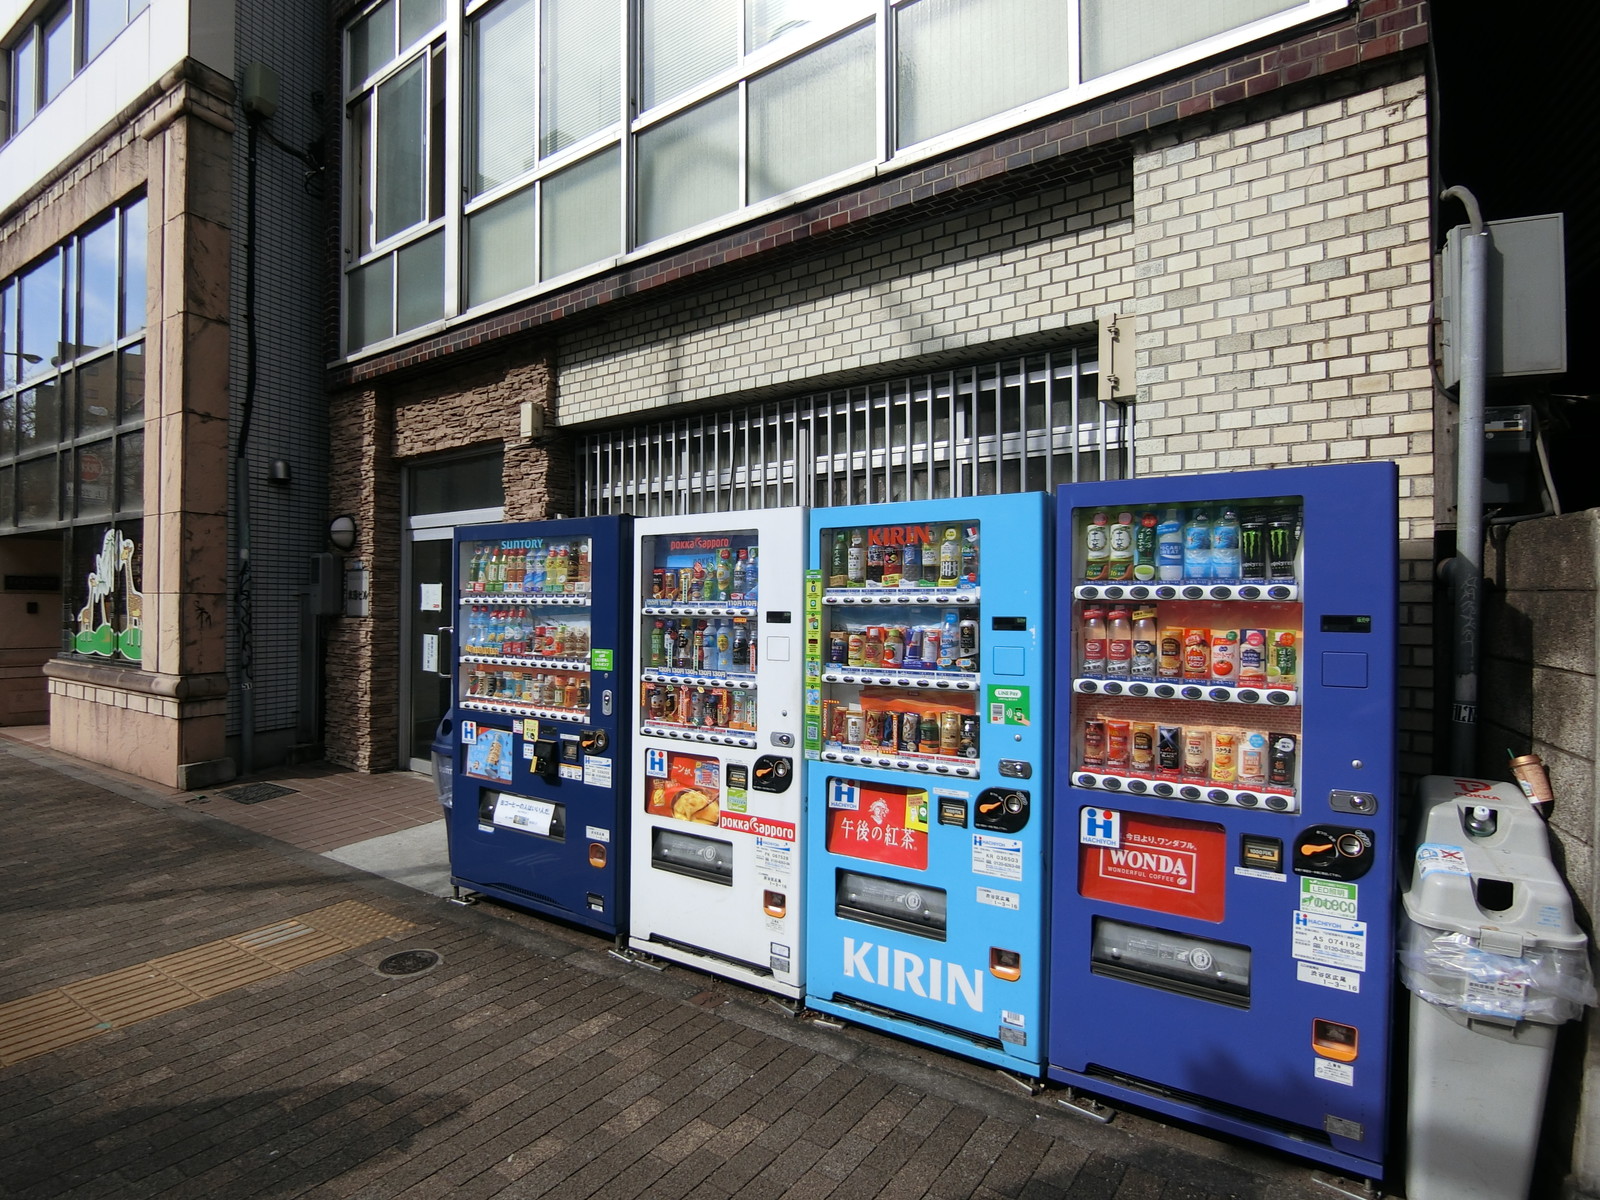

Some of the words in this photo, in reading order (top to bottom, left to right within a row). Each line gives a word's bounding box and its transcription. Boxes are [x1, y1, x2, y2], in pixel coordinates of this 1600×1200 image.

[868, 525, 930, 546] KIRIN
[501, 539, 543, 550] SUNTORY
[1454, 791, 1501, 801] POKKA
[841, 817, 914, 850] 午後の紅茶
[1082, 836, 1117, 847] HACHIYOH
[1109, 848, 1187, 877] WONDA
[1107, 866, 1147, 878] WONDERFUL
[1148, 873, 1175, 883] COFFEE
[1312, 885, 1345, 898] LED照明
[1308, 919, 1342, 929] HACHIYOH
[1313, 935, 1324, 943] AS
[1328, 938, 1361, 950] 074192
[843, 936, 984, 1013] KIRIN
